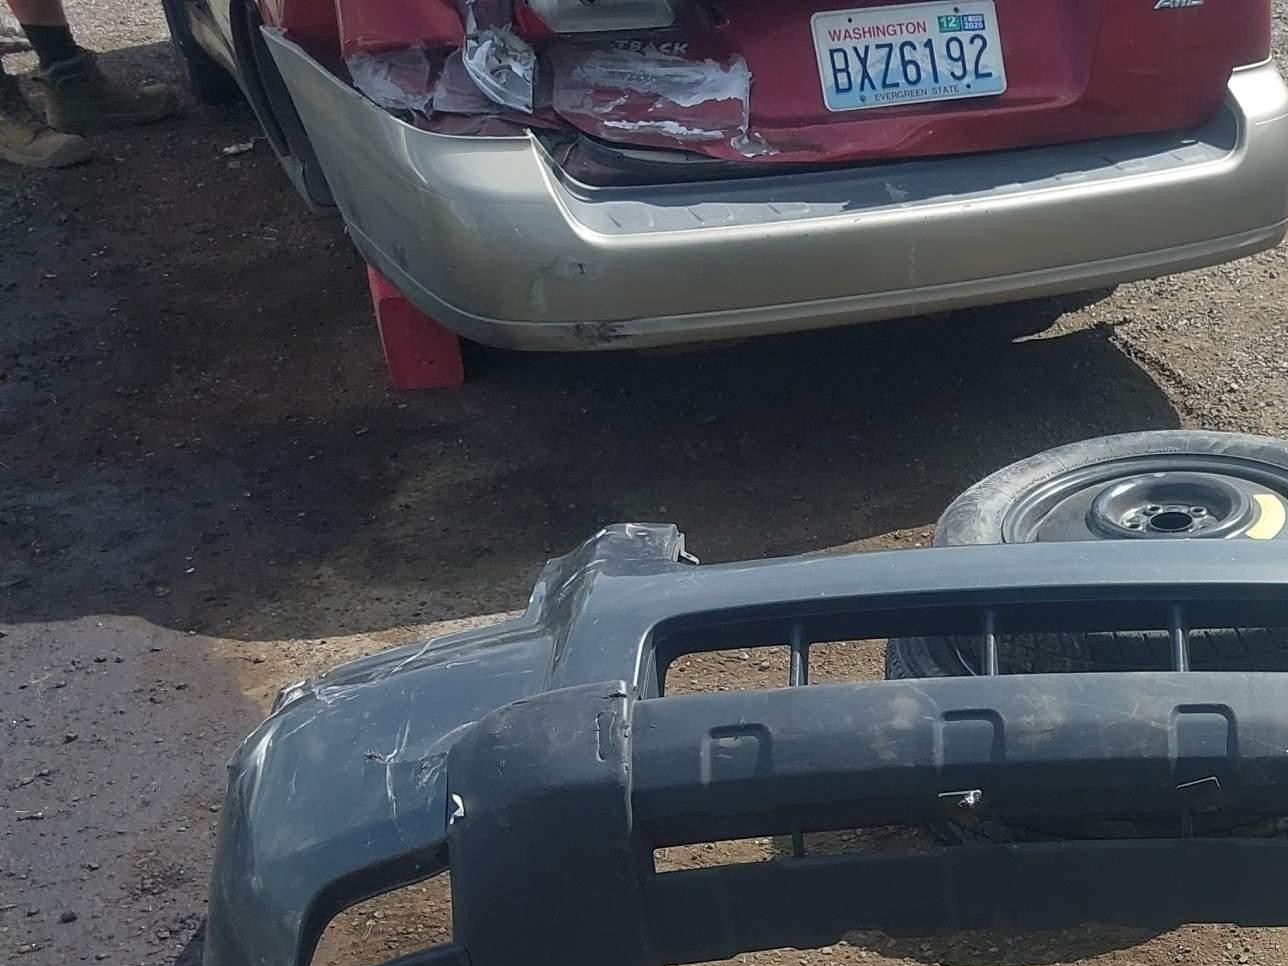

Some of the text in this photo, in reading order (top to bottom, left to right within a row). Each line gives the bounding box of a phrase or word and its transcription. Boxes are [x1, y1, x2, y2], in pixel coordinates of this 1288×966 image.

[828, 21, 927, 42] WASHINGTON
[940, 16, 957, 28] 12
[829, 34, 993, 94] BXZ6192
[874, 85, 959, 102] EVERGREEN STATE
